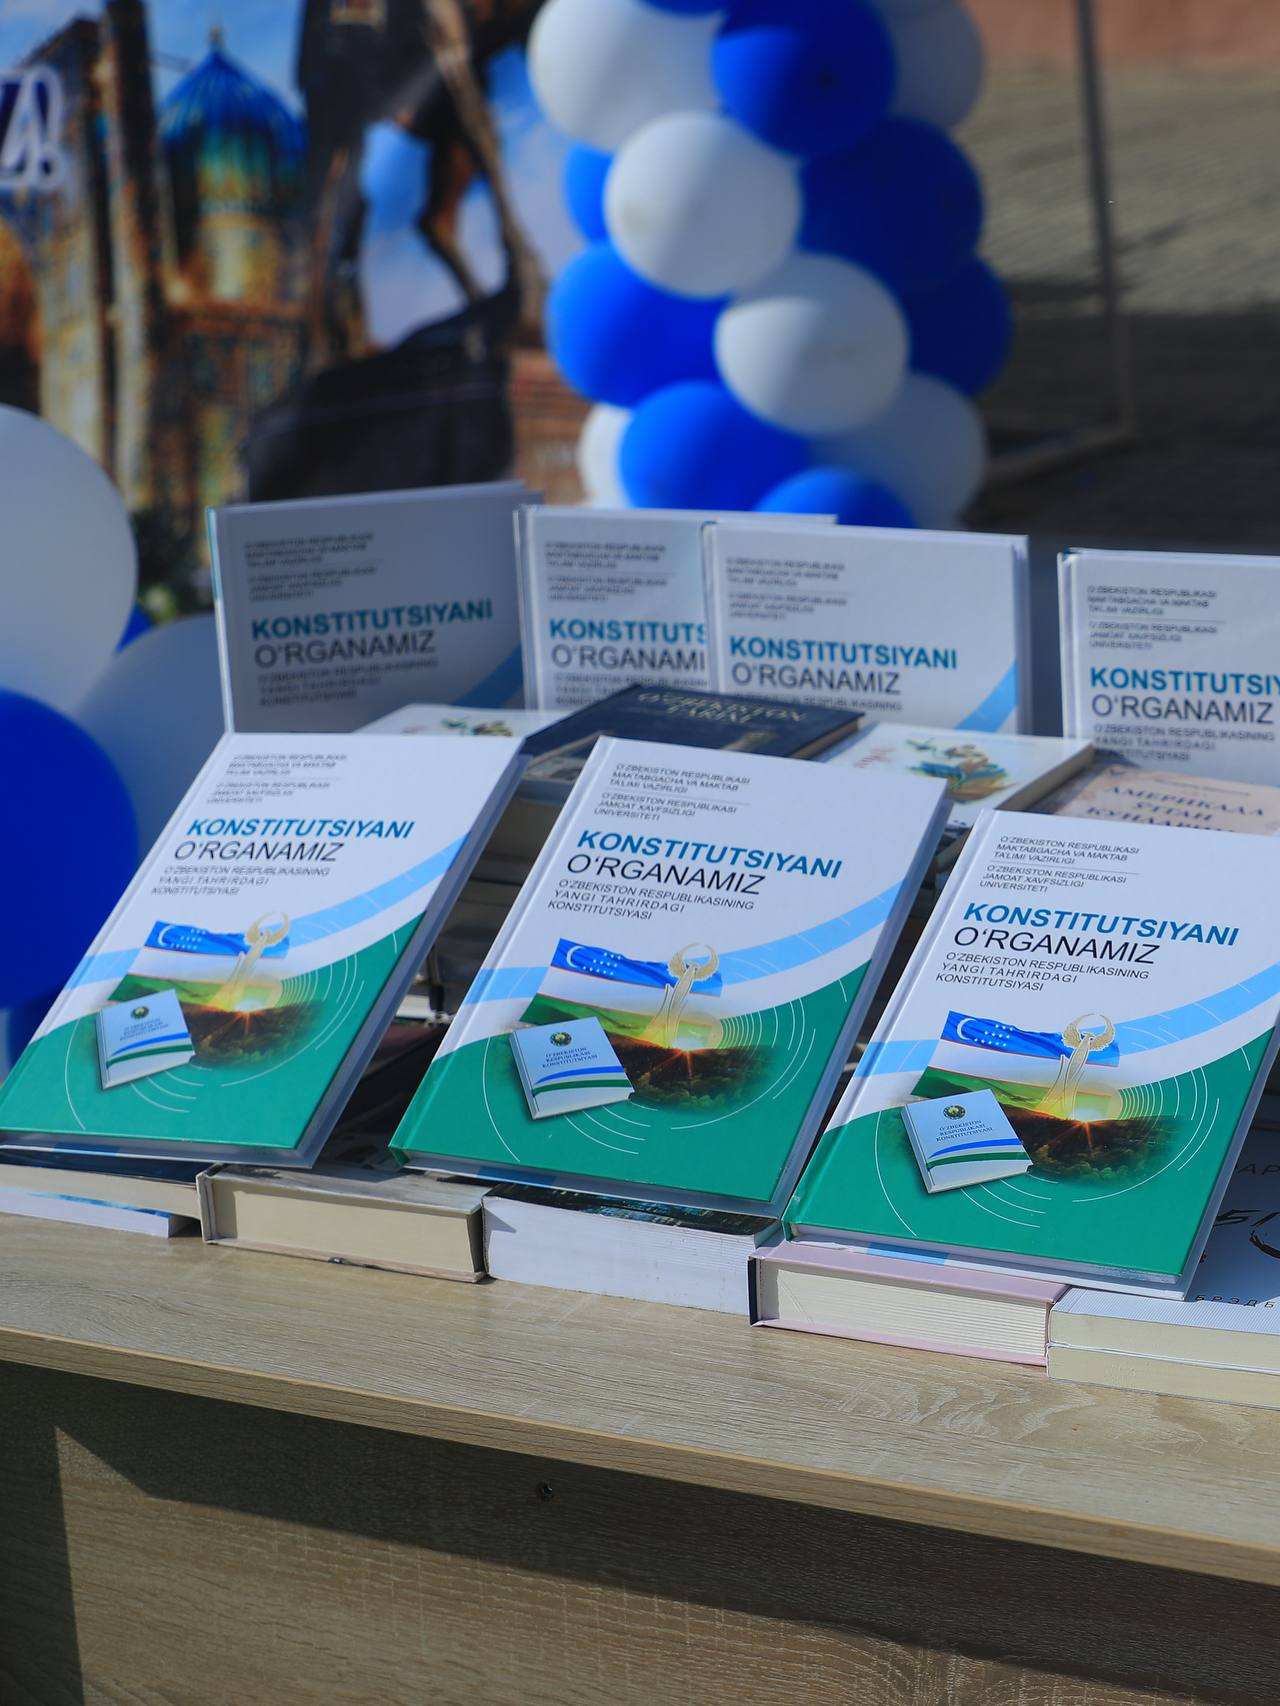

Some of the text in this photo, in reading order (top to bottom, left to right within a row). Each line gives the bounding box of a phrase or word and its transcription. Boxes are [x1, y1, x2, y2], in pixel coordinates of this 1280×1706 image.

[729, 636, 958, 671] KONSTITUTSIYANI
[185, 818, 416, 839] KONSTITUTSIYANI
[576, 829, 843, 879] KONSTITUTSIYANI
[995, 843, 1129, 862] MAKTABGACHA VA MAKTAB
[1066, 841, 1141, 855] RESPUBLIKASI
[1028, 854, 1076, 865] VAZIRLIGI
[978, 880, 1049, 893] UNIVERSITETI
[982, 872, 1085, 888] JAMOAT XAVFSIZLIGI
[1053, 870, 1128, 884] RESPUBLIKASI
[962, 902, 1240, 947] KONSTITUTSIYANI
[942, 962, 1078, 984] YANGI TAHRIRDAGI
[1028, 959, 1150, 980] RESPUBLIKASINING
[935, 972, 1045, 992] KONSTITUTSIYASI
